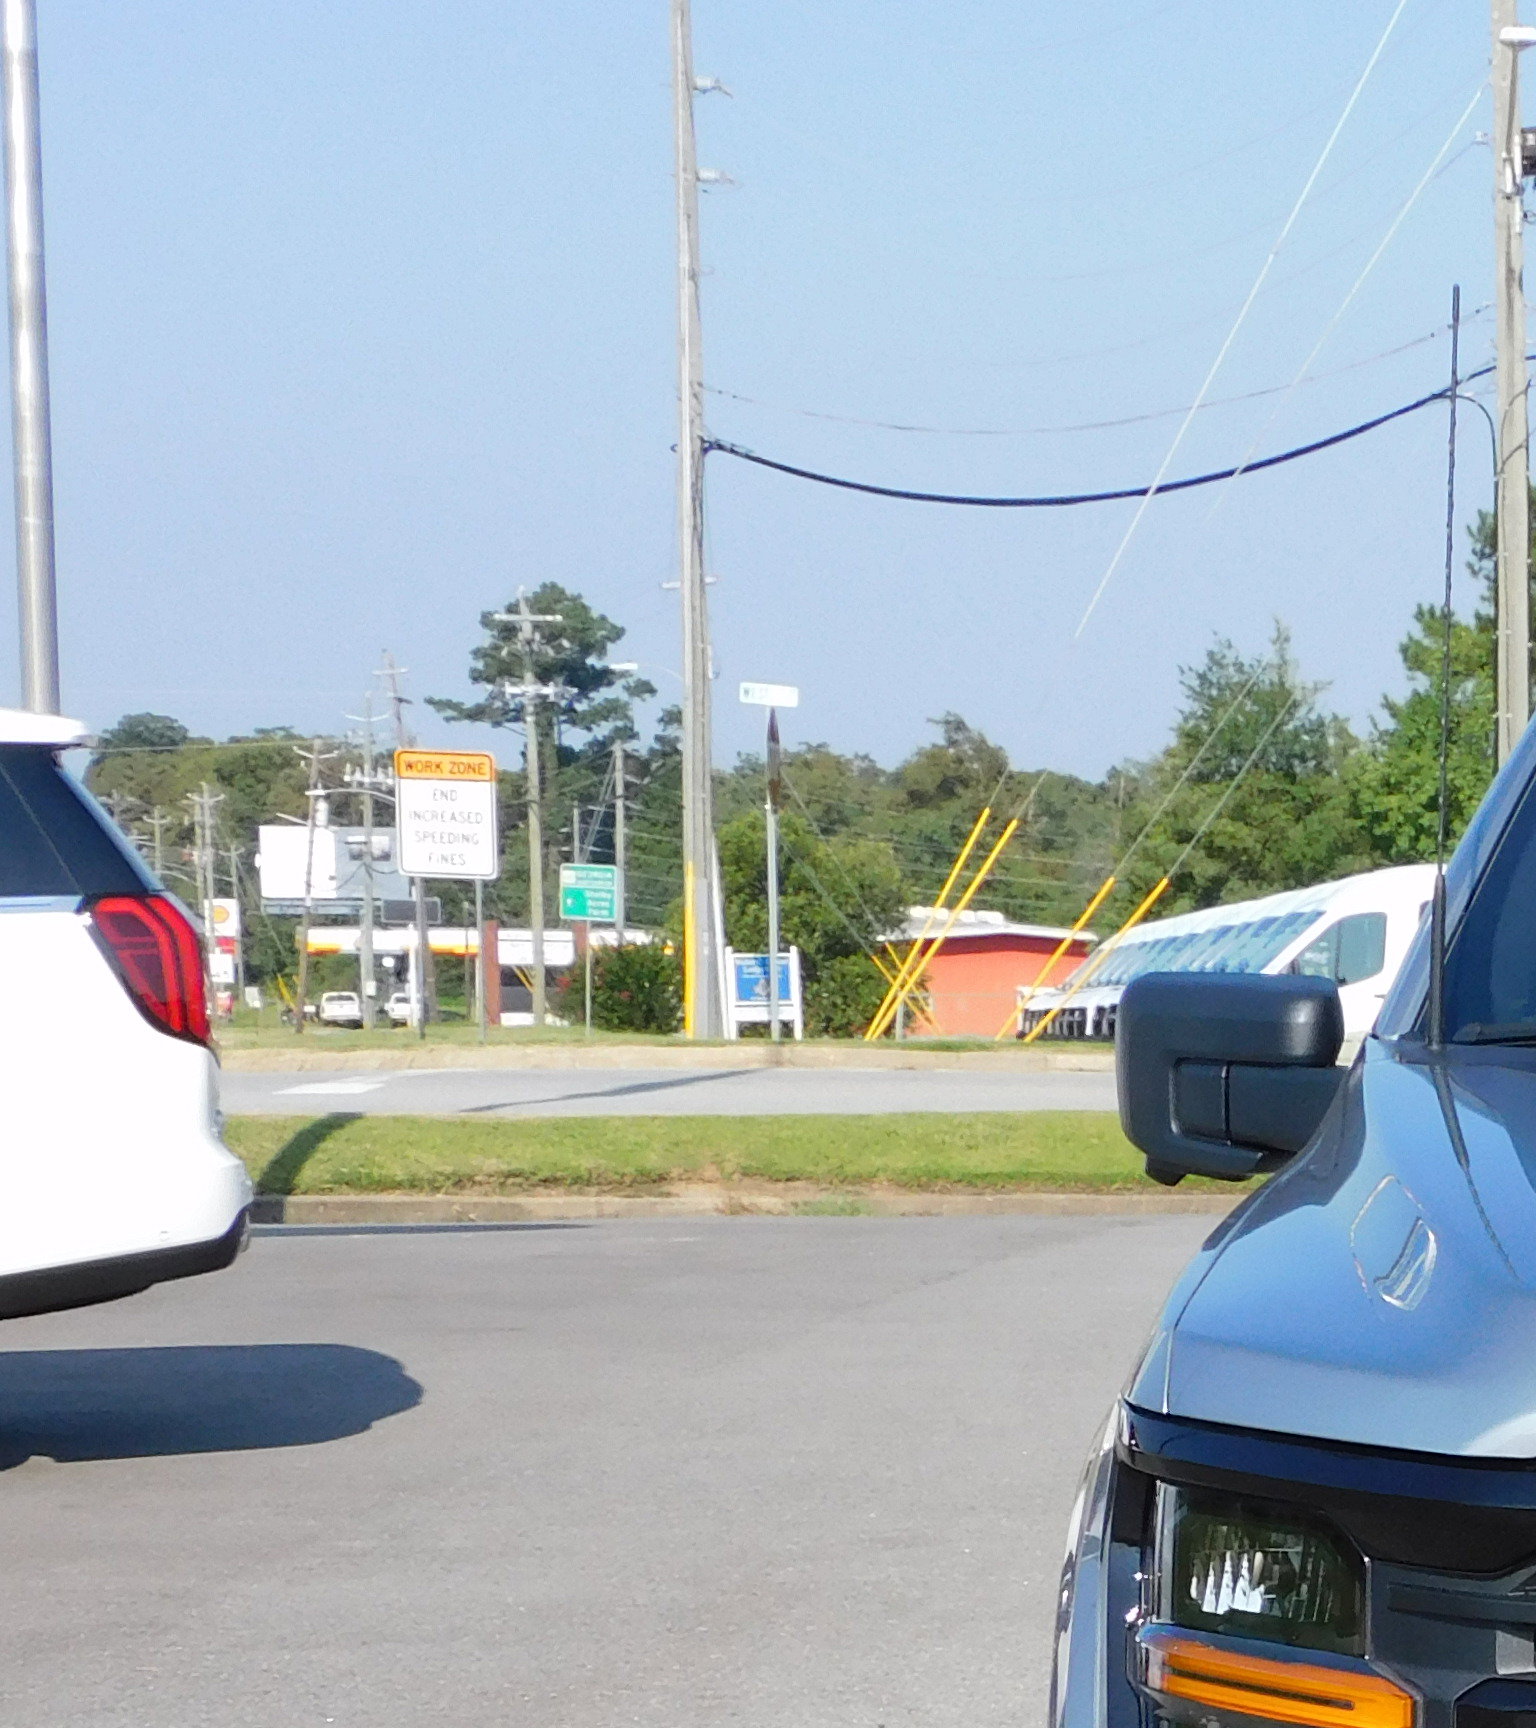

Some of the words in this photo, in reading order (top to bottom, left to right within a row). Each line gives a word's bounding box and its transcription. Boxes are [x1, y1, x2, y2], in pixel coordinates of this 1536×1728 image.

[404, 760, 444, 774] WORK
[449, 761, 487, 776] ZONE
[432, 788, 458, 801] END
[408, 809, 483, 824] INCREASED
[415, 830, 479, 845] SPEEDING
[428, 852, 466, 866] FINES
